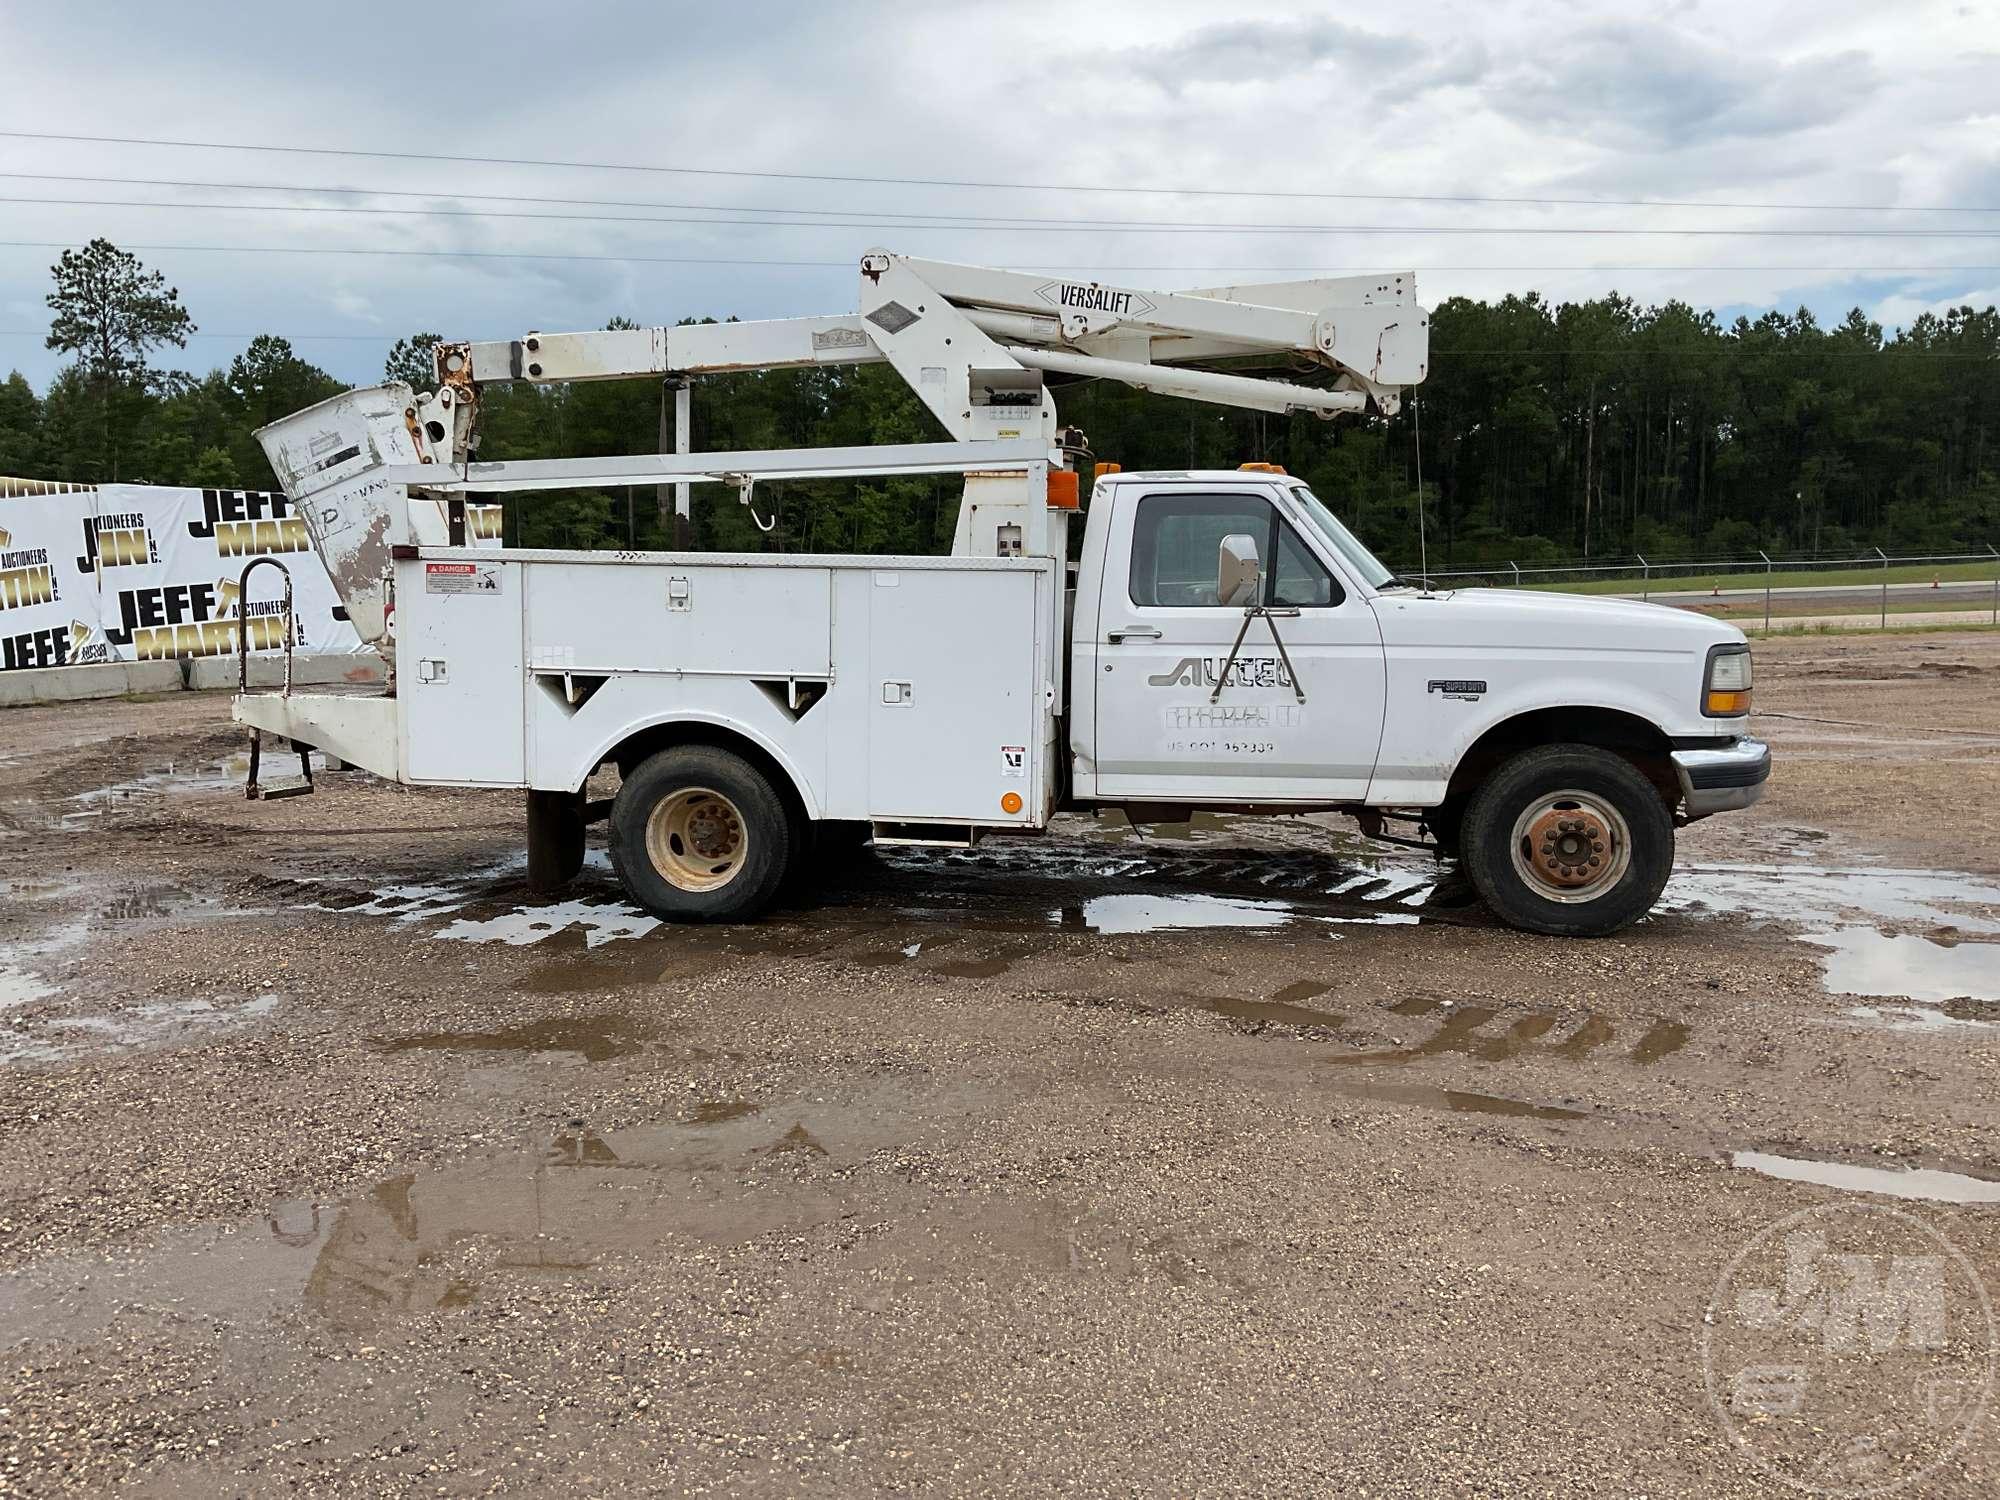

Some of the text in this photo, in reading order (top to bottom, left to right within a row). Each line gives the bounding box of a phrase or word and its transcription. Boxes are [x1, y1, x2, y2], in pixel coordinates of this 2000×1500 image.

[1061, 285, 1132, 313] VERSALIFT
[1, 548, 48, 569] AUCTIONEERS
[0, 566, 52, 611] TIN
[232, 600, 290, 619] ACTIONEER
[104, 583, 216, 646] JEFF
[0, 626, 72, 671] JEFF
[134, 615, 296, 661] MARTIN
